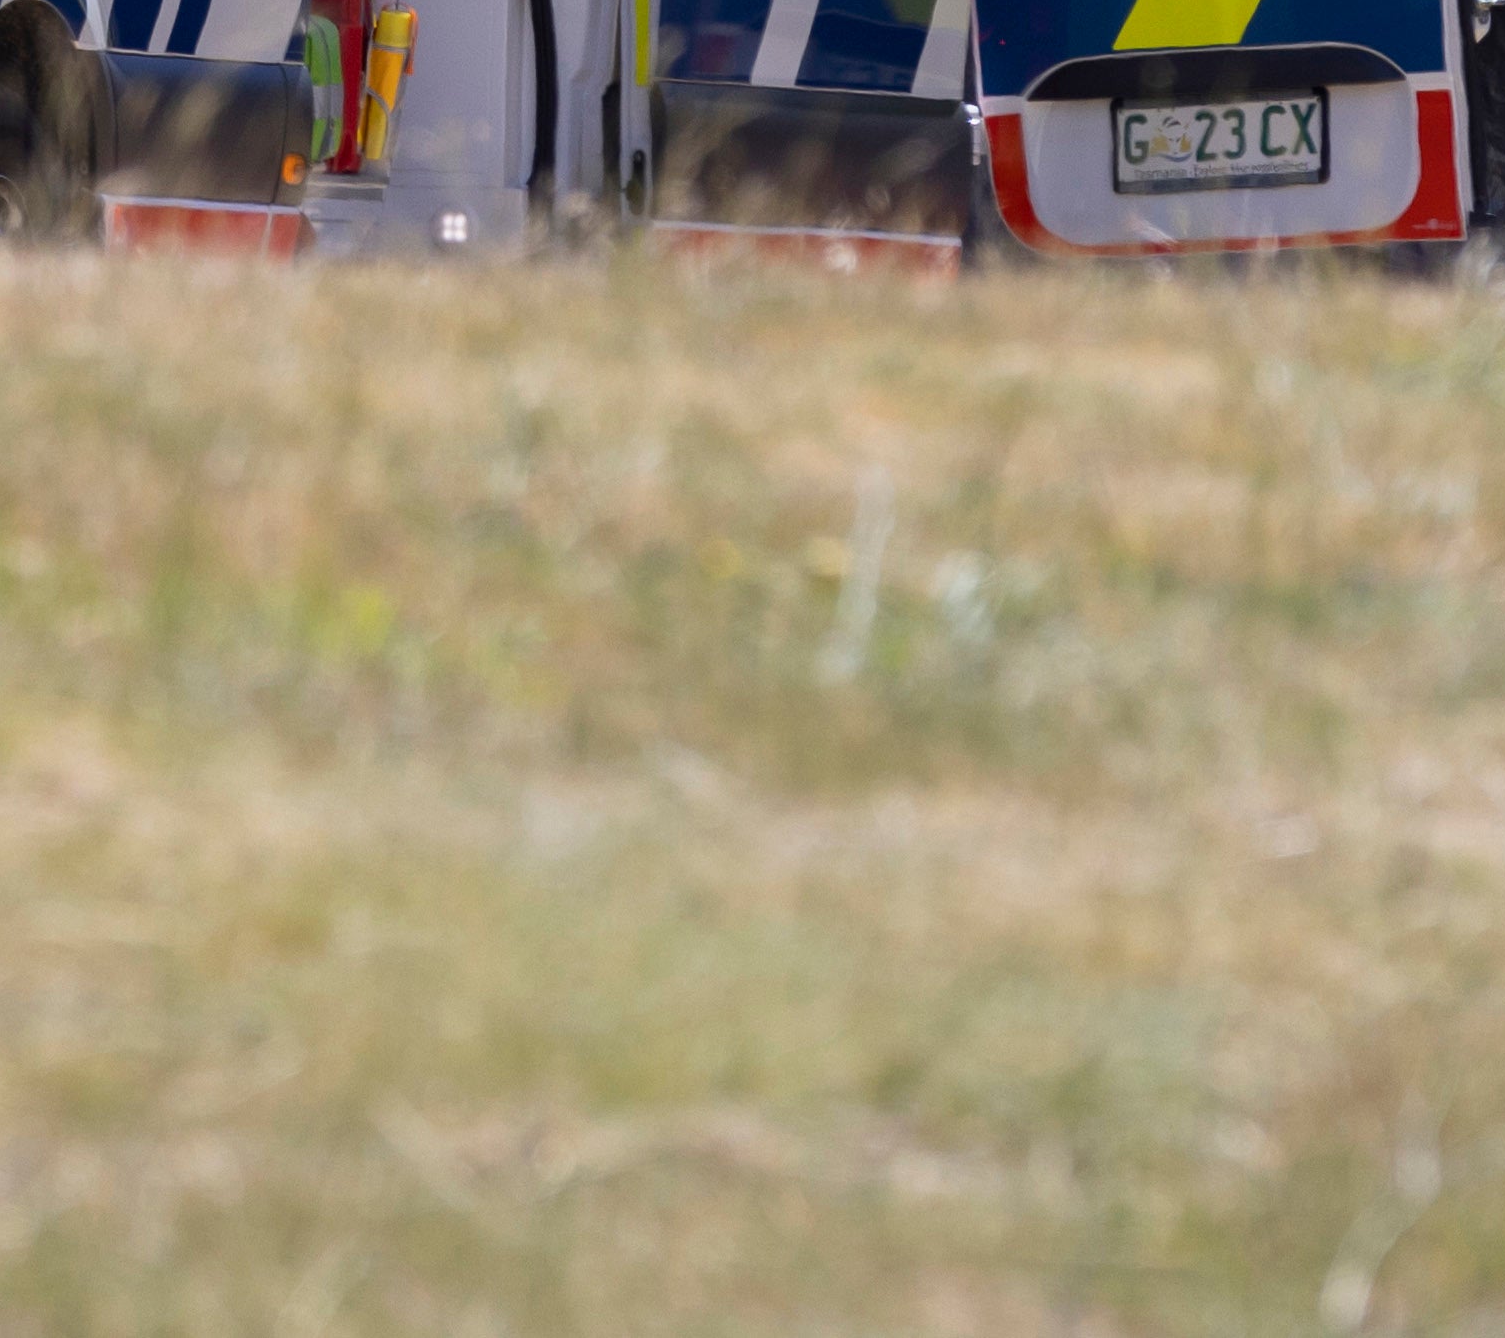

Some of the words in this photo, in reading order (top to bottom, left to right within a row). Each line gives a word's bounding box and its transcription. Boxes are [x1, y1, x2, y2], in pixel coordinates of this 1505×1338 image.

[1123, 113, 1150, 165] G
[1195, 108, 1246, 163] 23
[1260, 102, 1318, 157] CX
